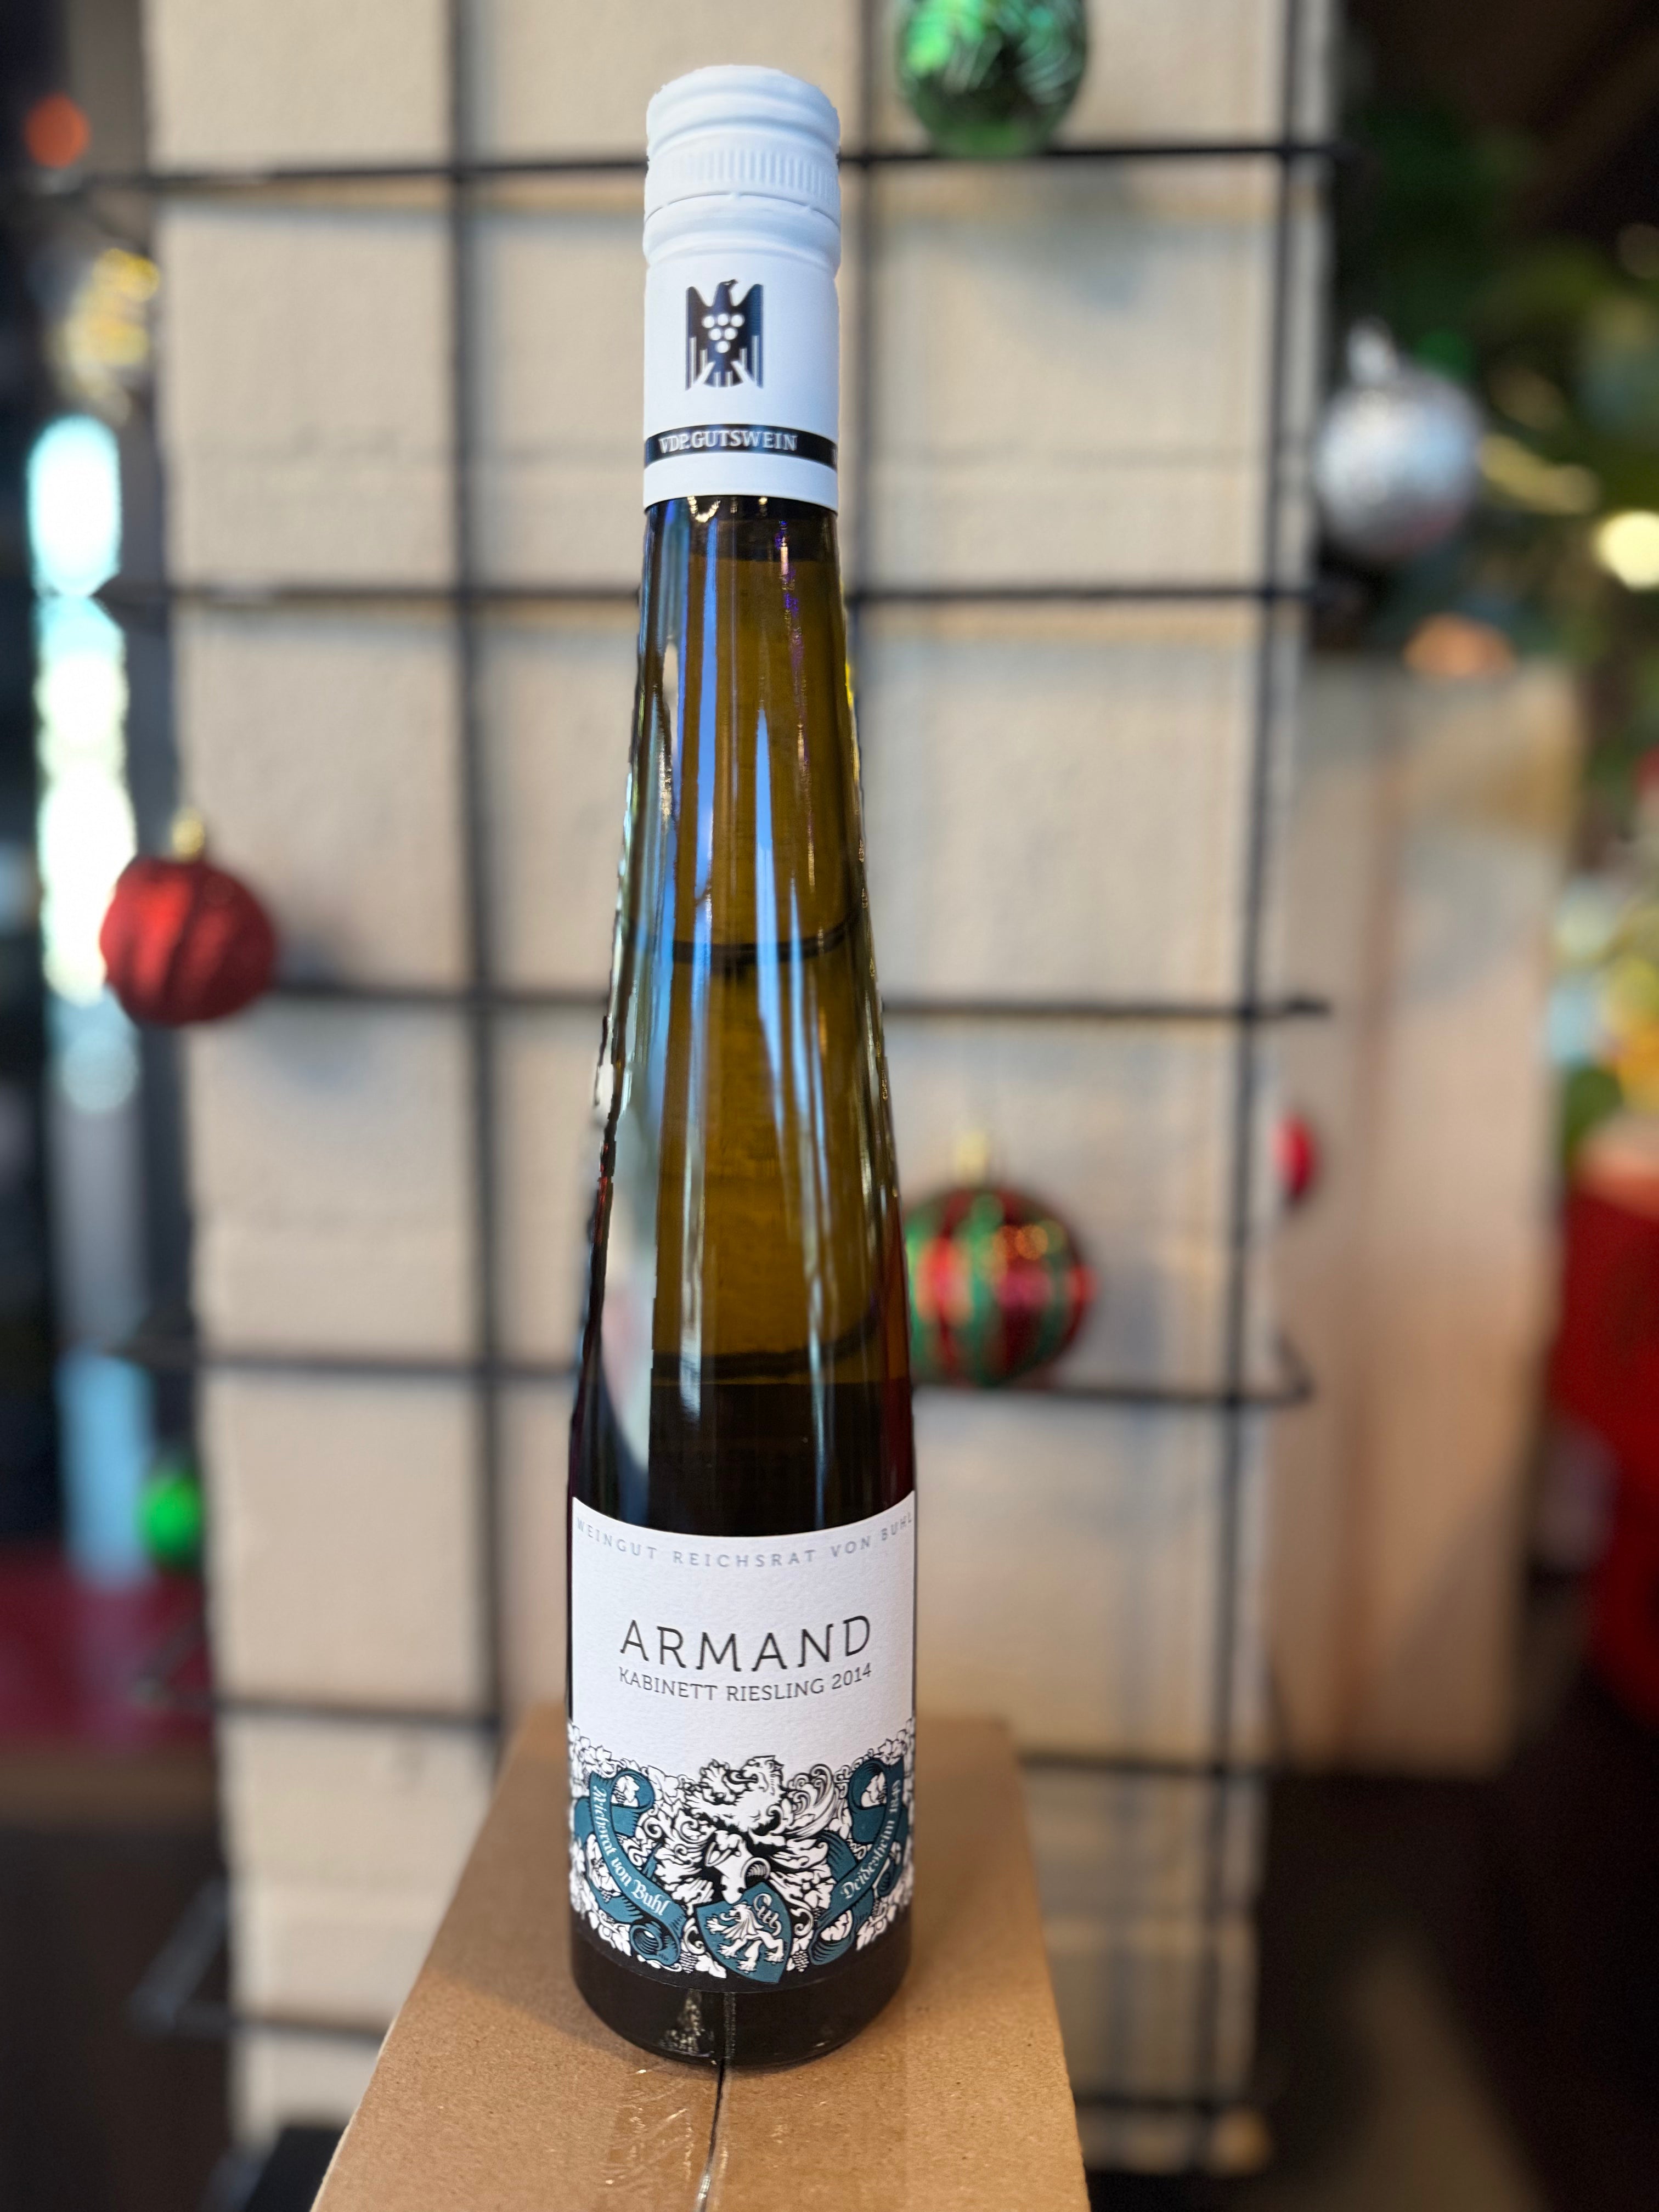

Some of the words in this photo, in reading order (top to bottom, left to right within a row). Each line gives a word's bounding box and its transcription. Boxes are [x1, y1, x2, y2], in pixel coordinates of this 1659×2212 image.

[577, 1517, 658, 1560] WEINGUT
[673, 1549, 817, 1568] REICHSRAT
[830, 1535, 871, 1558] VON
[881, 1511, 912, 1541] BUHL
[620, 1615, 871, 1672] ARMAND
[619, 1666, 718, 1701] KABINETT
[726, 1678, 825, 1702] RIESLING
[832, 1662, 872, 1690] 2014
[611, 1857, 632, 1887] von
[632, 1879, 672, 1916] Buhl
[840, 1820, 895, 1899] Deidesheim
